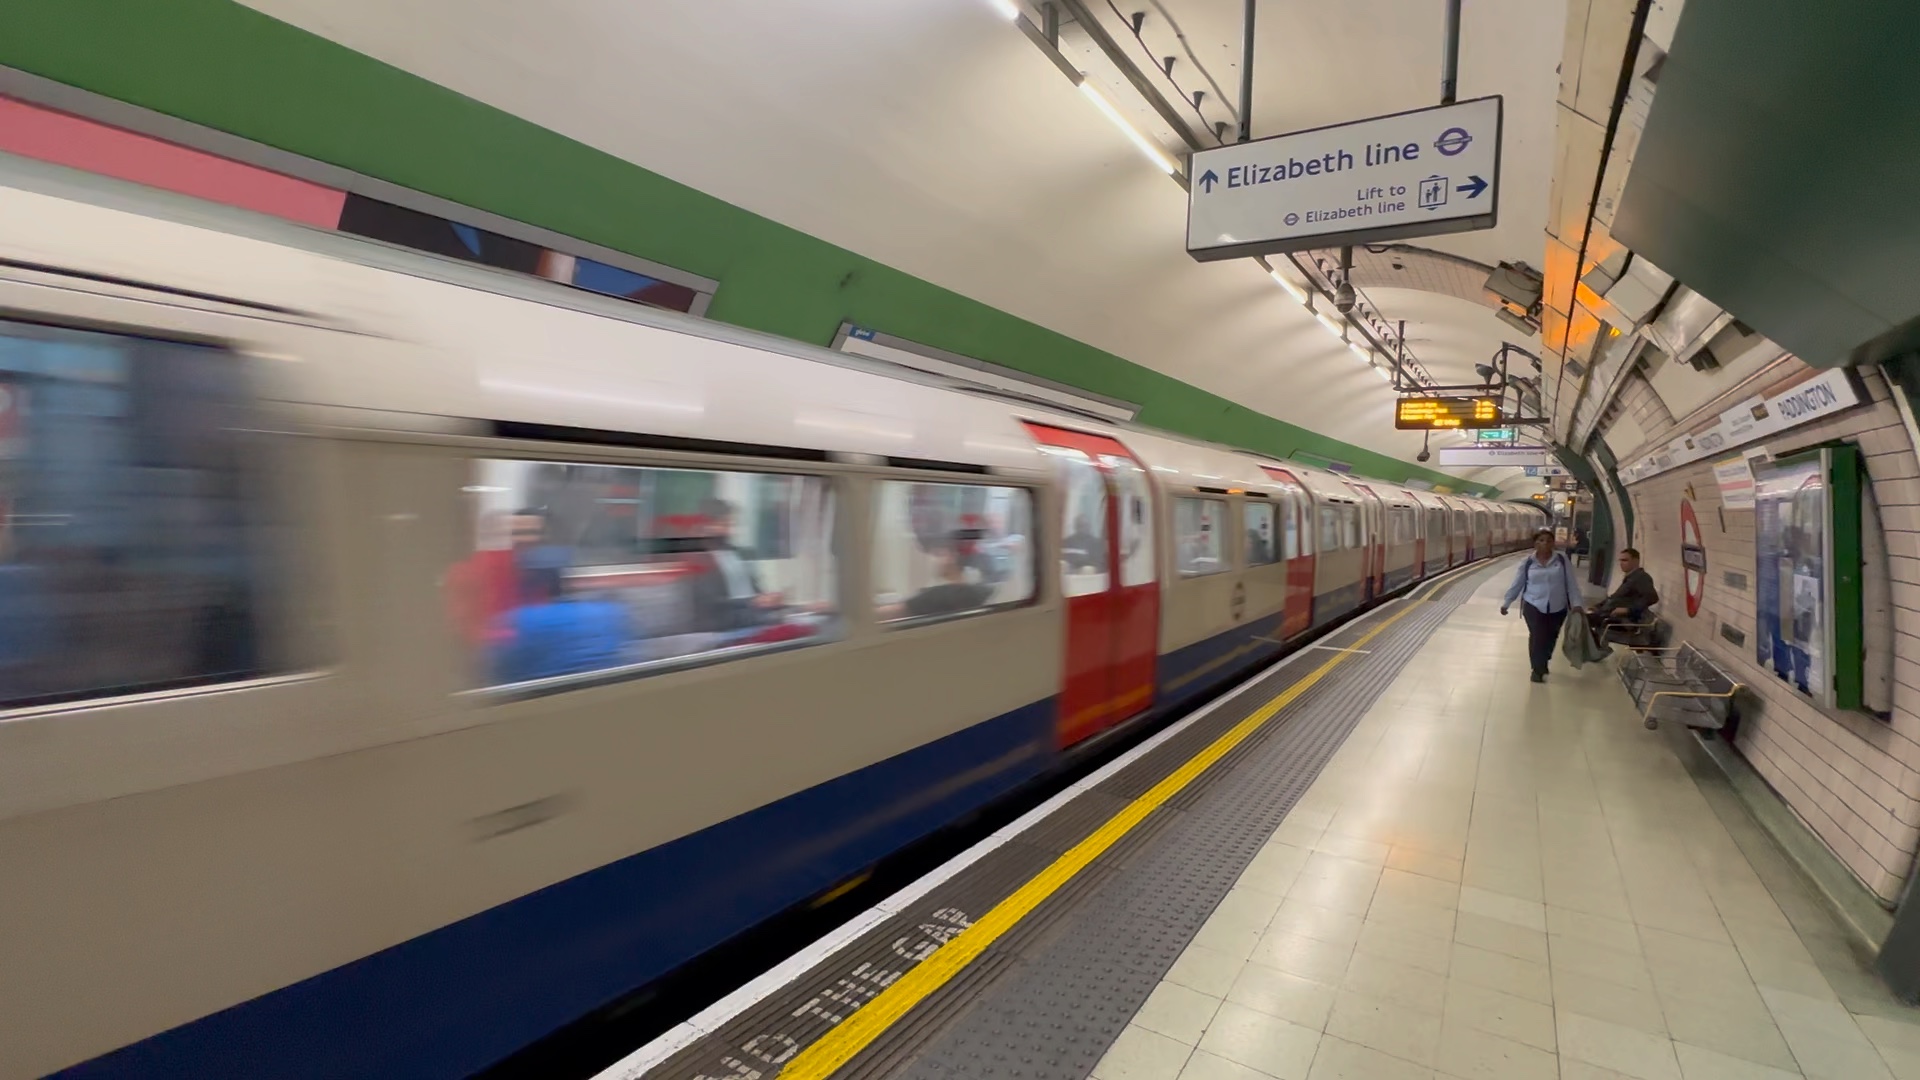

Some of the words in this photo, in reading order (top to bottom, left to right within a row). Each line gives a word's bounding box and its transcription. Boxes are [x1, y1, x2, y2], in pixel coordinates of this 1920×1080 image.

[1227, 149, 1353, 189] Elizabeth
[1365, 142, 1420, 167] line
[1306, 204, 1373, 224] Elizabeth
[1378, 200, 1405, 215] line
[1357, 187, 1383, 201] Lift
[1389, 185, 1406, 197] to
[1777, 380, 1837, 420] PADDINGTON
[792, 962, 902, 1023] THE
[892, 907, 976, 961] GAP
